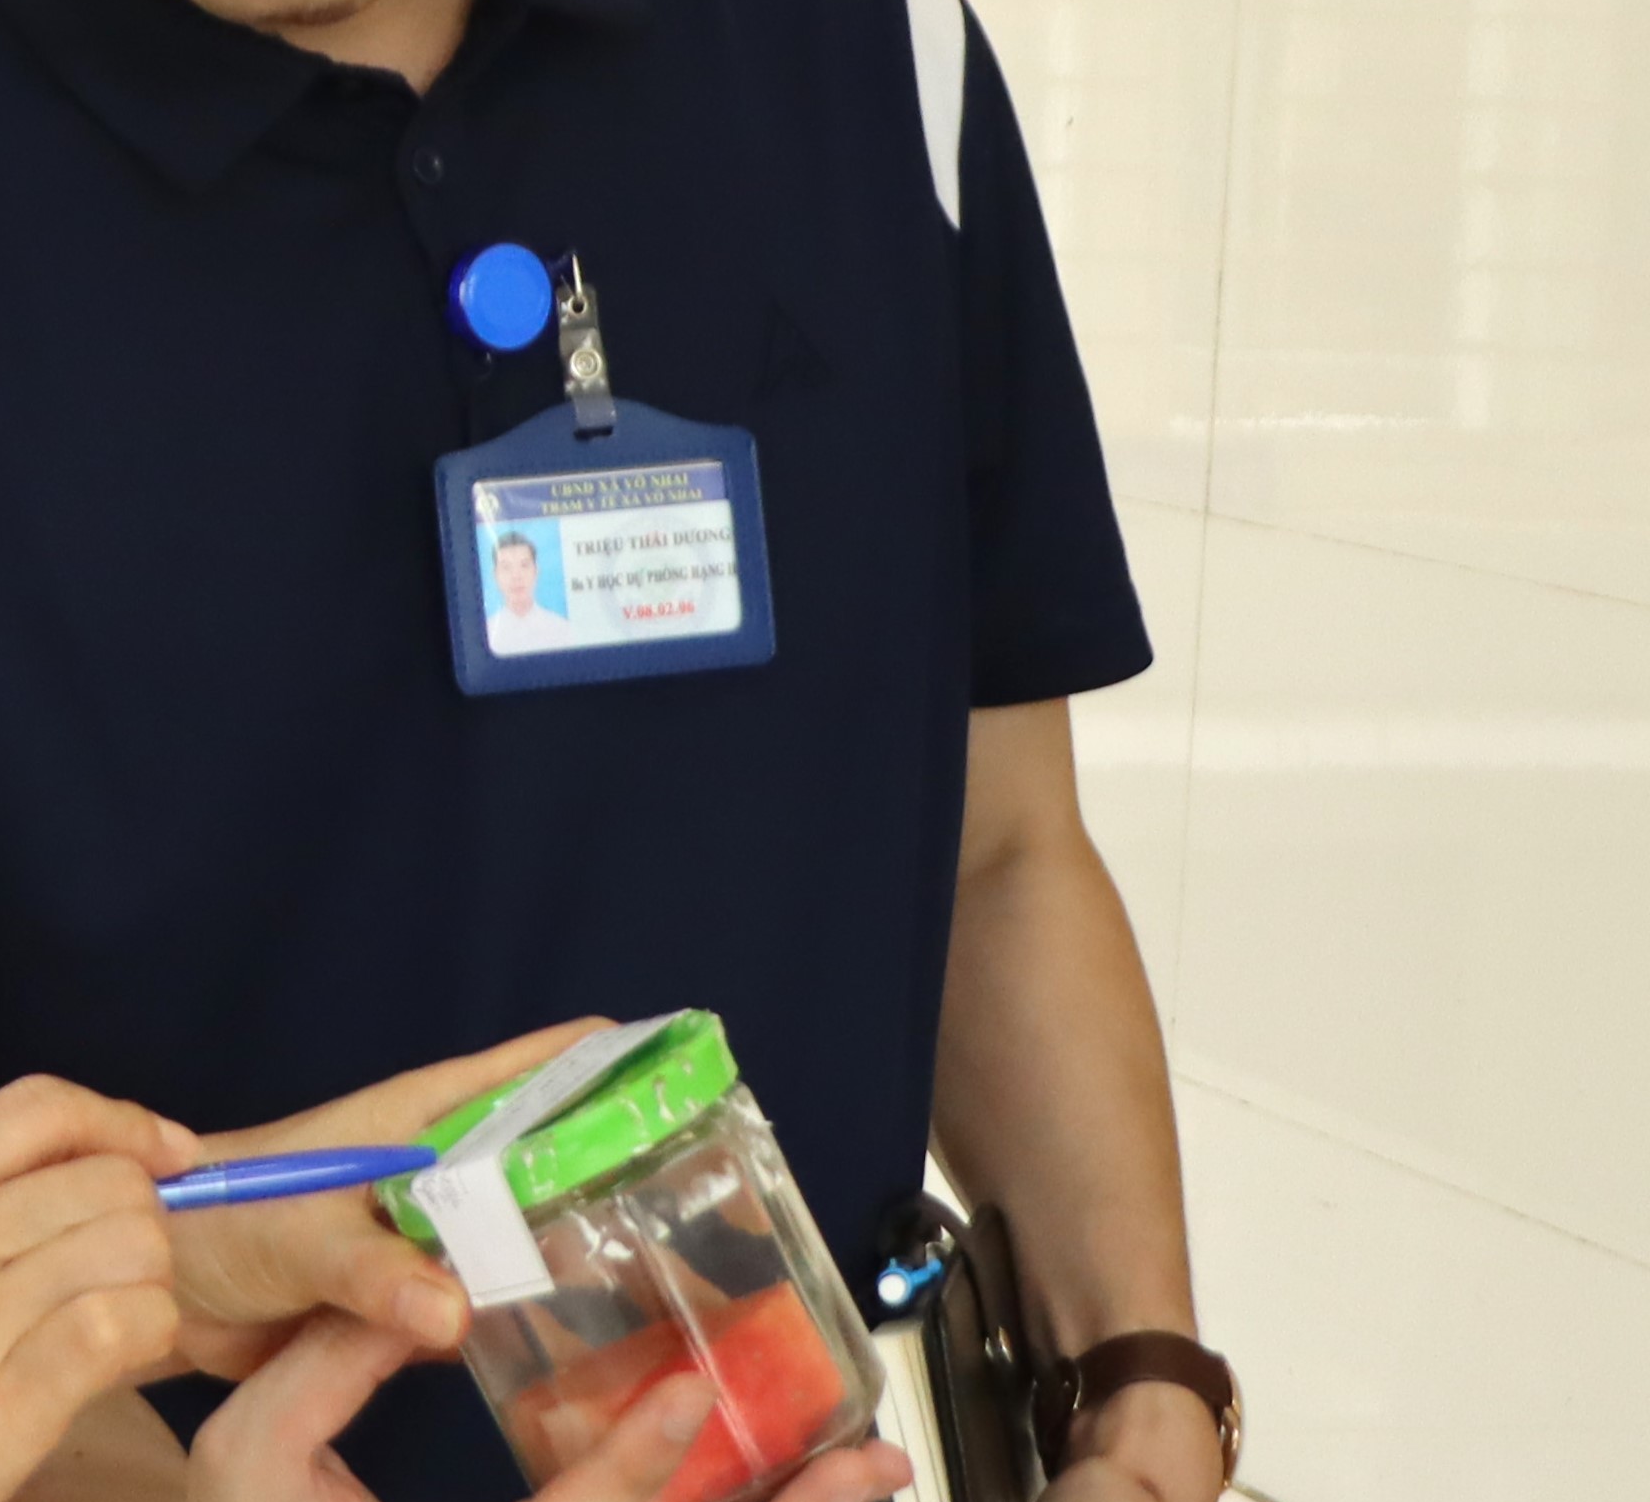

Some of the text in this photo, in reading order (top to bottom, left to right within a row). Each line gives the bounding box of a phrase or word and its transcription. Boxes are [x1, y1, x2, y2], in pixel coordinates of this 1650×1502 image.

[551, 482, 594, 498] UBND
[573, 526, 733, 557] TRIỆU THÁI DƯƠNG
[585, 575, 596, 590] Y
[598, 573, 623, 593] HỌC
[646, 565, 689, 586] PHÒNG
[691, 562, 724, 584] HẠNG
